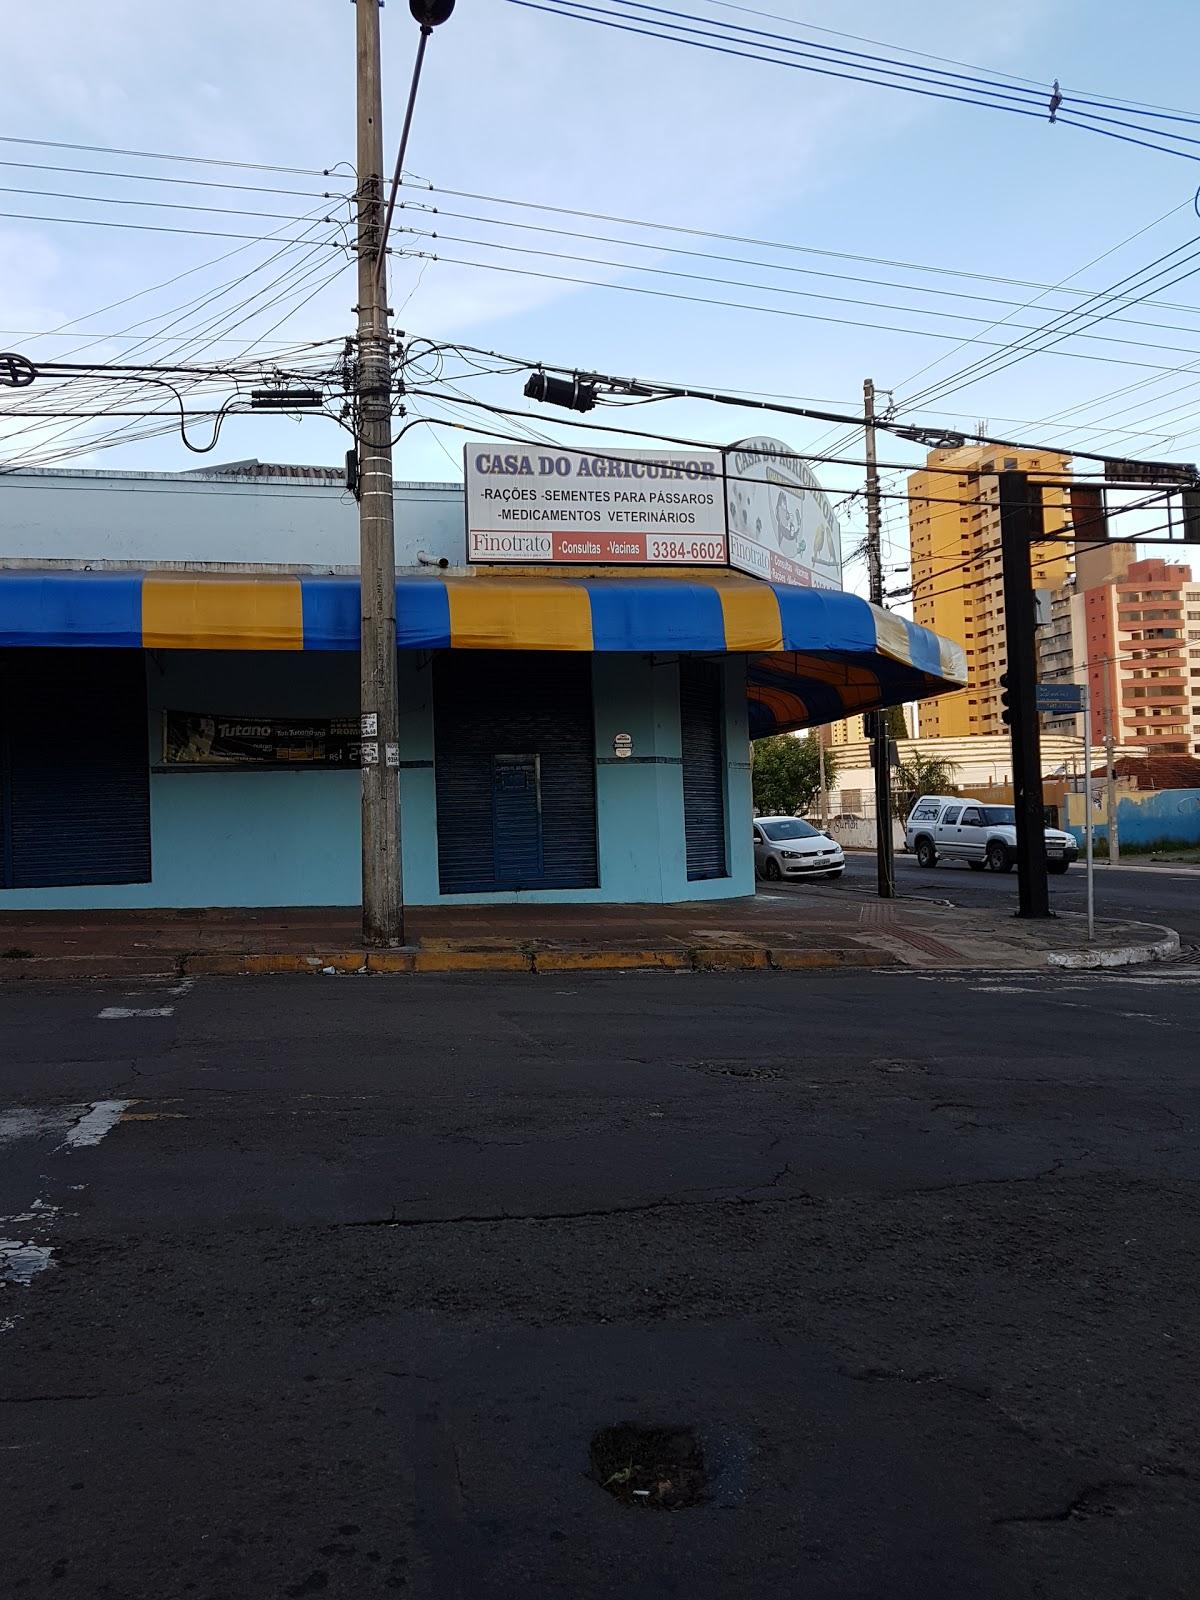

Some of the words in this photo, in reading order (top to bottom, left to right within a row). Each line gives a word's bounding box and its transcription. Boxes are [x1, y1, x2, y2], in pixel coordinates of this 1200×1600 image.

[475, 453, 534, 476] CASA
[538, 456, 572, 477] DO
[576, 457, 717, 481] AGRICULTOR
[480, 486, 537, 503] -RAÇÕES
[614, 491, 647, 503] PARA
[649, 490, 714, 505] PÁSSAROS
[497, 508, 601, 522] -MEDICAMENTOS
[607, 509, 696, 524] VETERINÁRIOS
[472, 533, 551, 553] Finotrato
[652, 541, 724, 560] 3384-6602
[730, 533, 769, 569] Finotrato
[217, 723, 272, 738] Tutano
[330, 728, 361, 736] PROM
